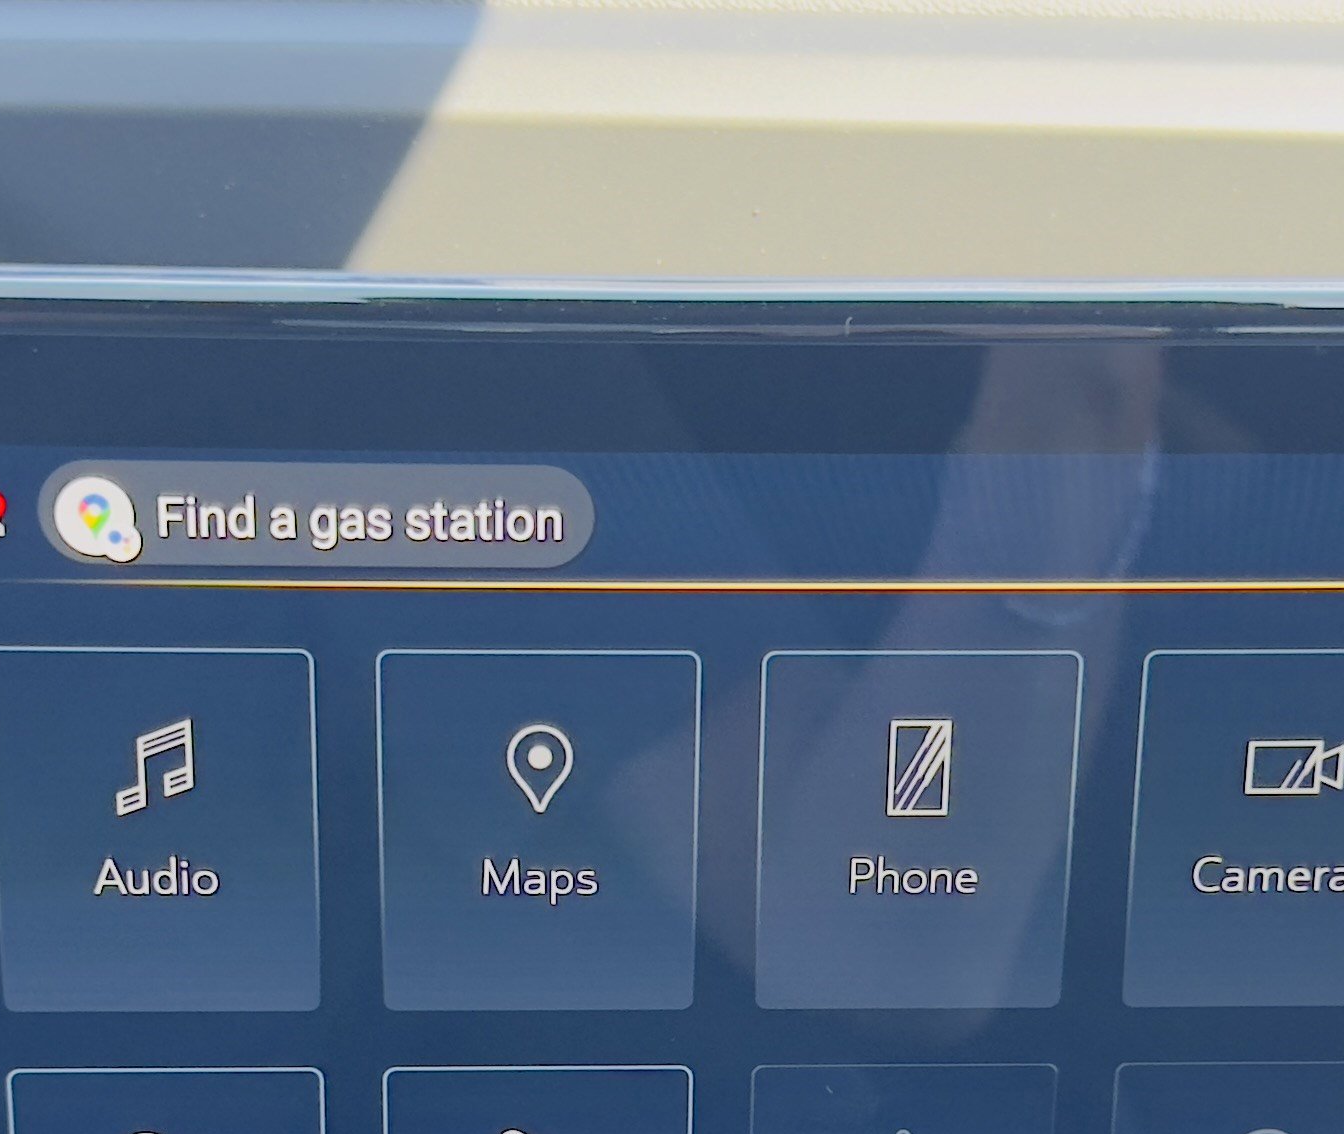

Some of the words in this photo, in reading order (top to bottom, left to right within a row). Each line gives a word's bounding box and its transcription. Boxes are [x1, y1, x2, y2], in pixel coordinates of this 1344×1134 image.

[156, 495, 256, 541] Find
[269, 506, 297, 541] a
[309, 506, 393, 551] gas
[404, 498, 565, 542] station
[92, 856, 220, 898] Audio
[481, 857, 600, 906] Maps
[848, 856, 980, 895] Phone
